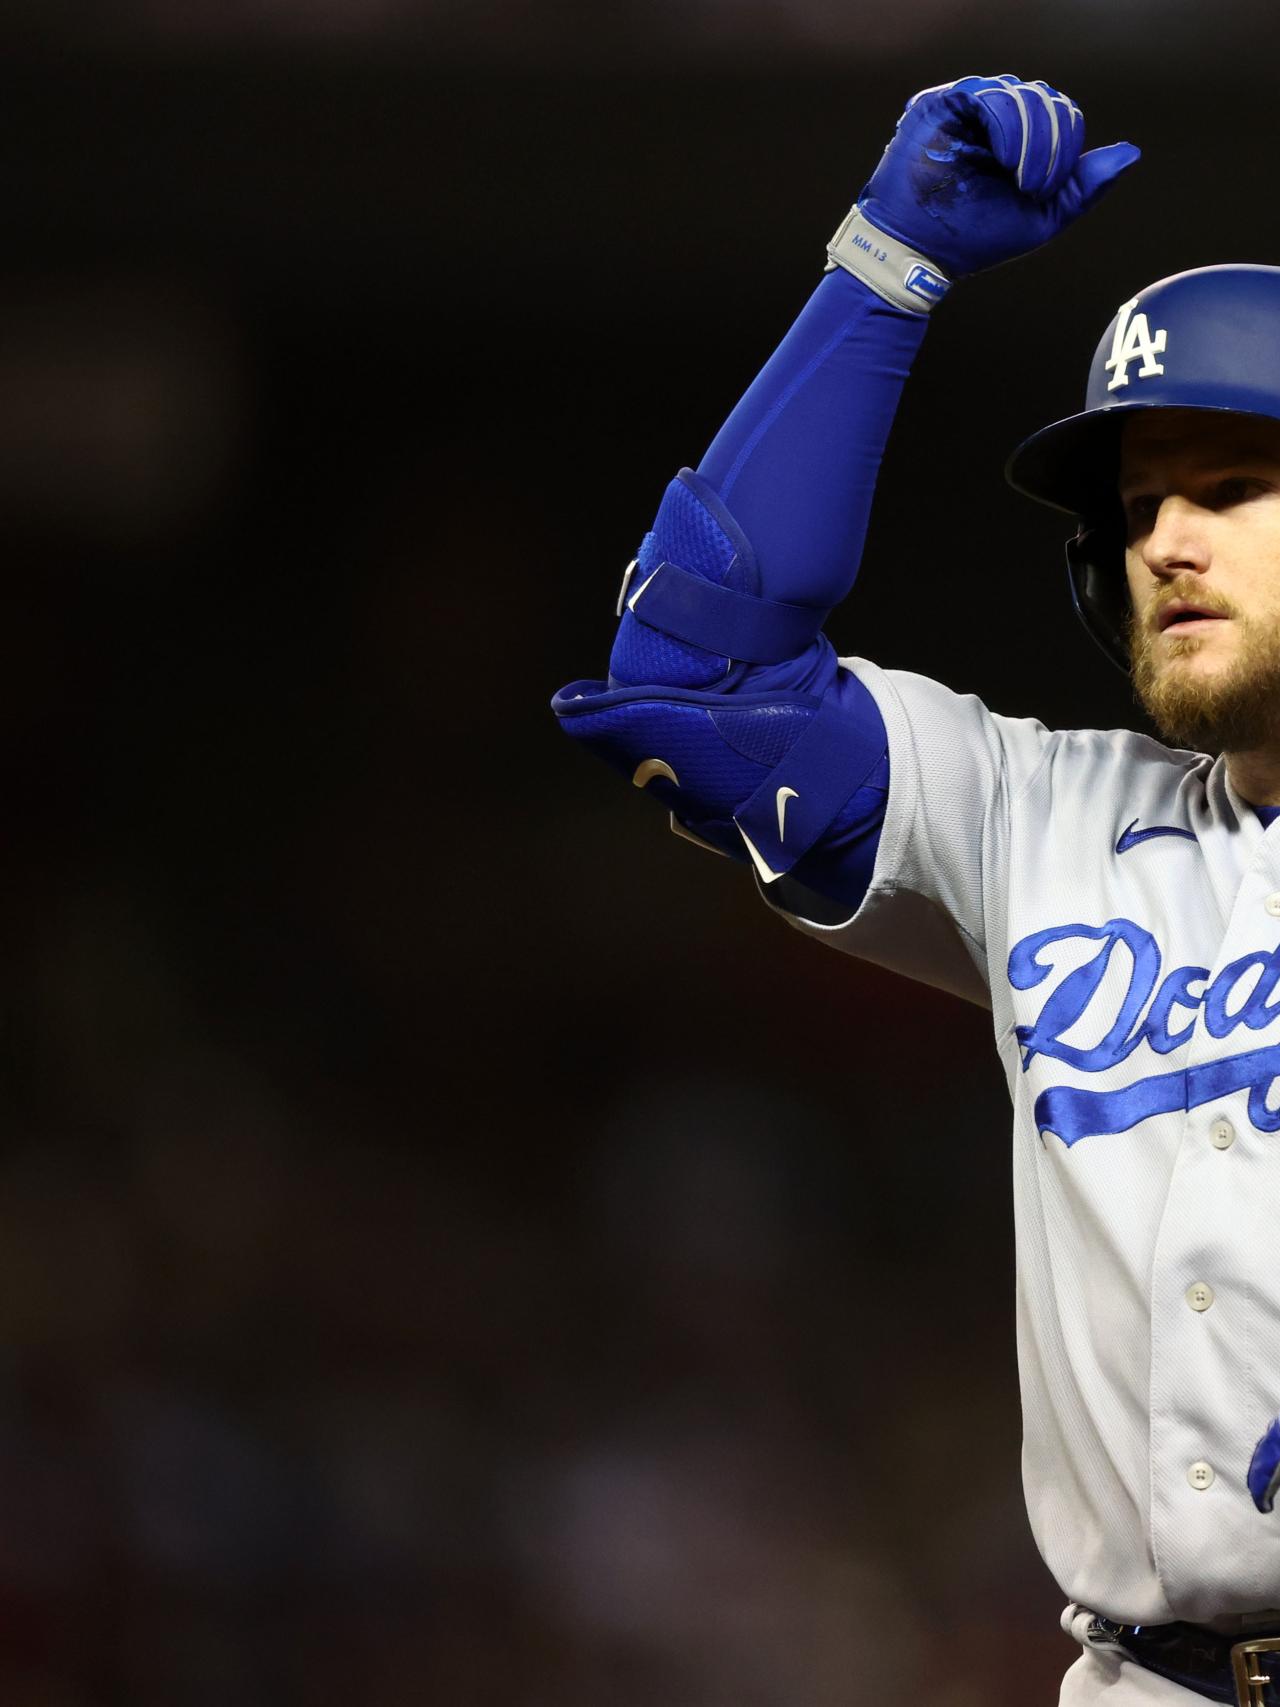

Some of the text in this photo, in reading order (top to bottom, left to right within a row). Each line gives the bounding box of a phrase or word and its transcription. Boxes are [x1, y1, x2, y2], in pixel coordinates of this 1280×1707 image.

[852, 234, 888, 262] MM 13
[1105, 298, 1168, 391] LA
